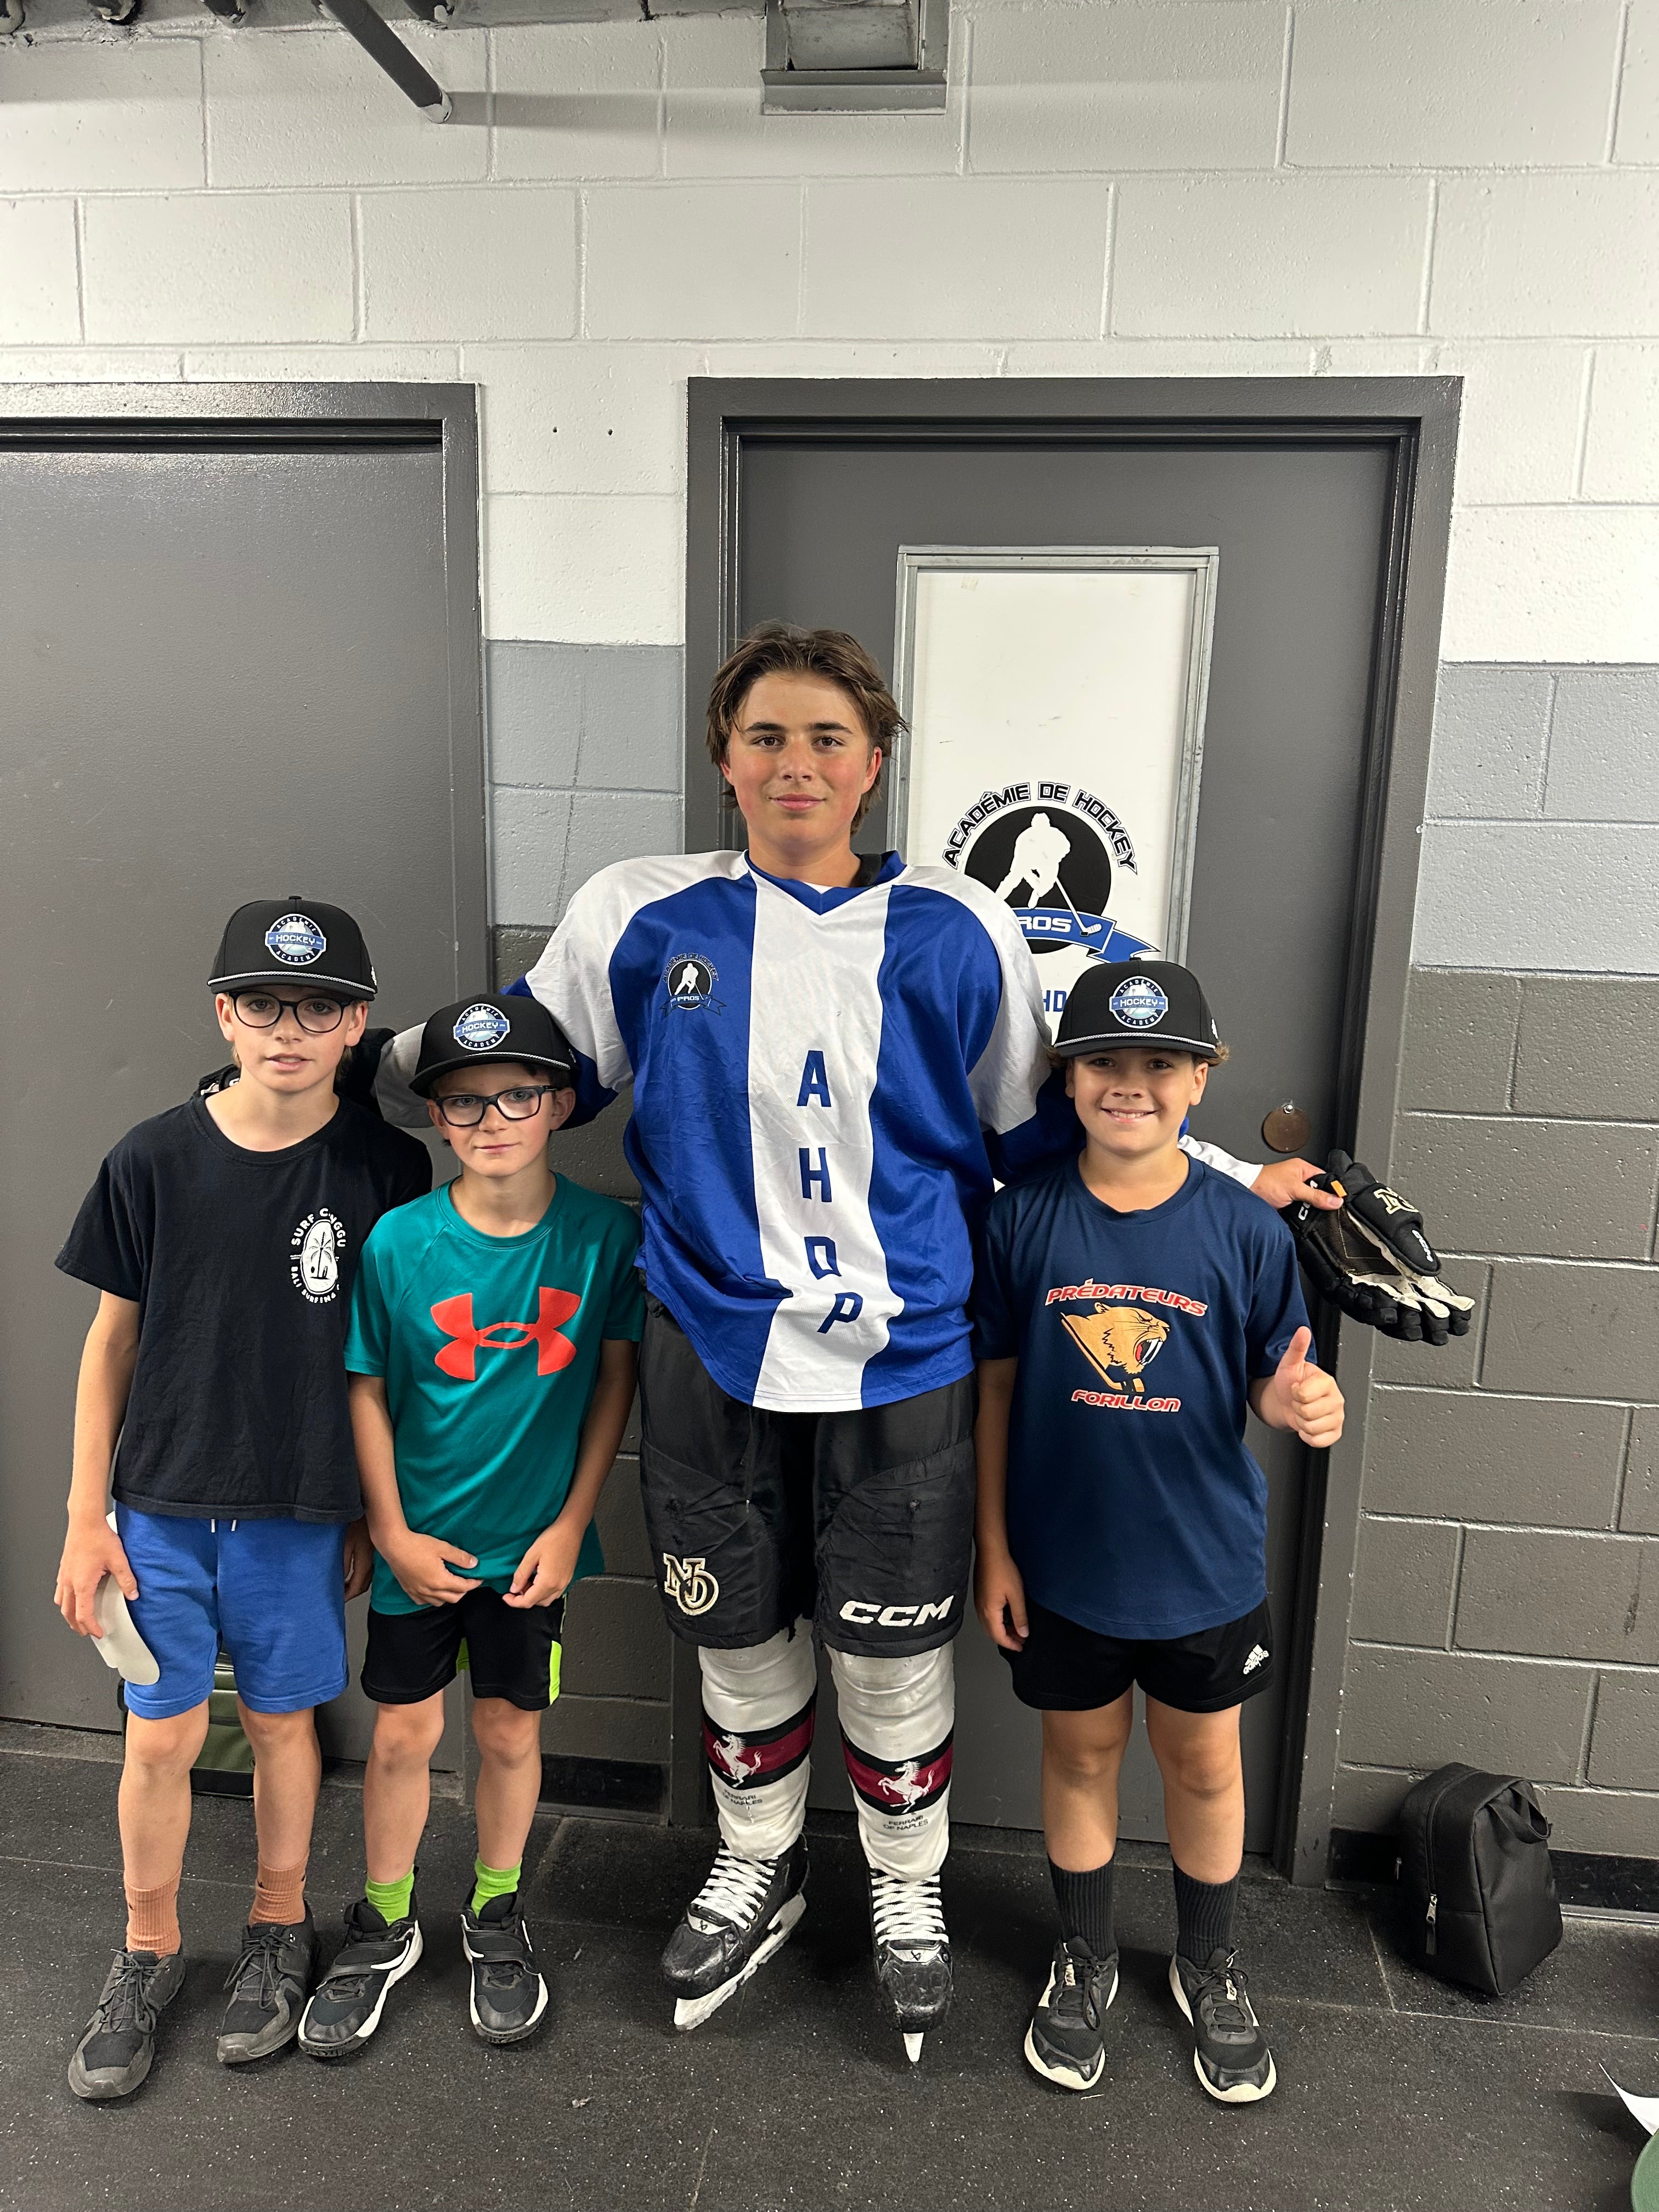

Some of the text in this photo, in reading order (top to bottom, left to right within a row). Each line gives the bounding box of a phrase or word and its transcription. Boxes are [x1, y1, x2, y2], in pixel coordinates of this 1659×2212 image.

[941, 781, 1138, 876] ACADÉMIE DE HOCKEY
[1017, 916, 1072, 933] ROS
[275, 934, 315, 945] HOCKEY
[276, 950, 315, 962] ACADEMY
[1120, 998, 1158, 1007] HOCKEY
[462, 1022, 498, 1034] HOCKEY
[1121, 1014, 1159, 1025] ACADEMY
[463, 1035, 500, 1047] ACADEMY
[291, 1214, 314, 1246] SURF
[291, 1266, 302, 1288] BALI
[1045, 1278, 1208, 1317] PRÉDATEURS
[1071, 1389, 1181, 1412] FORILLON
[839, 1595, 954, 1627] CCM
[1243, 1650, 1269, 1674] adidas
[897, 1819, 928, 1830] NAPLES
